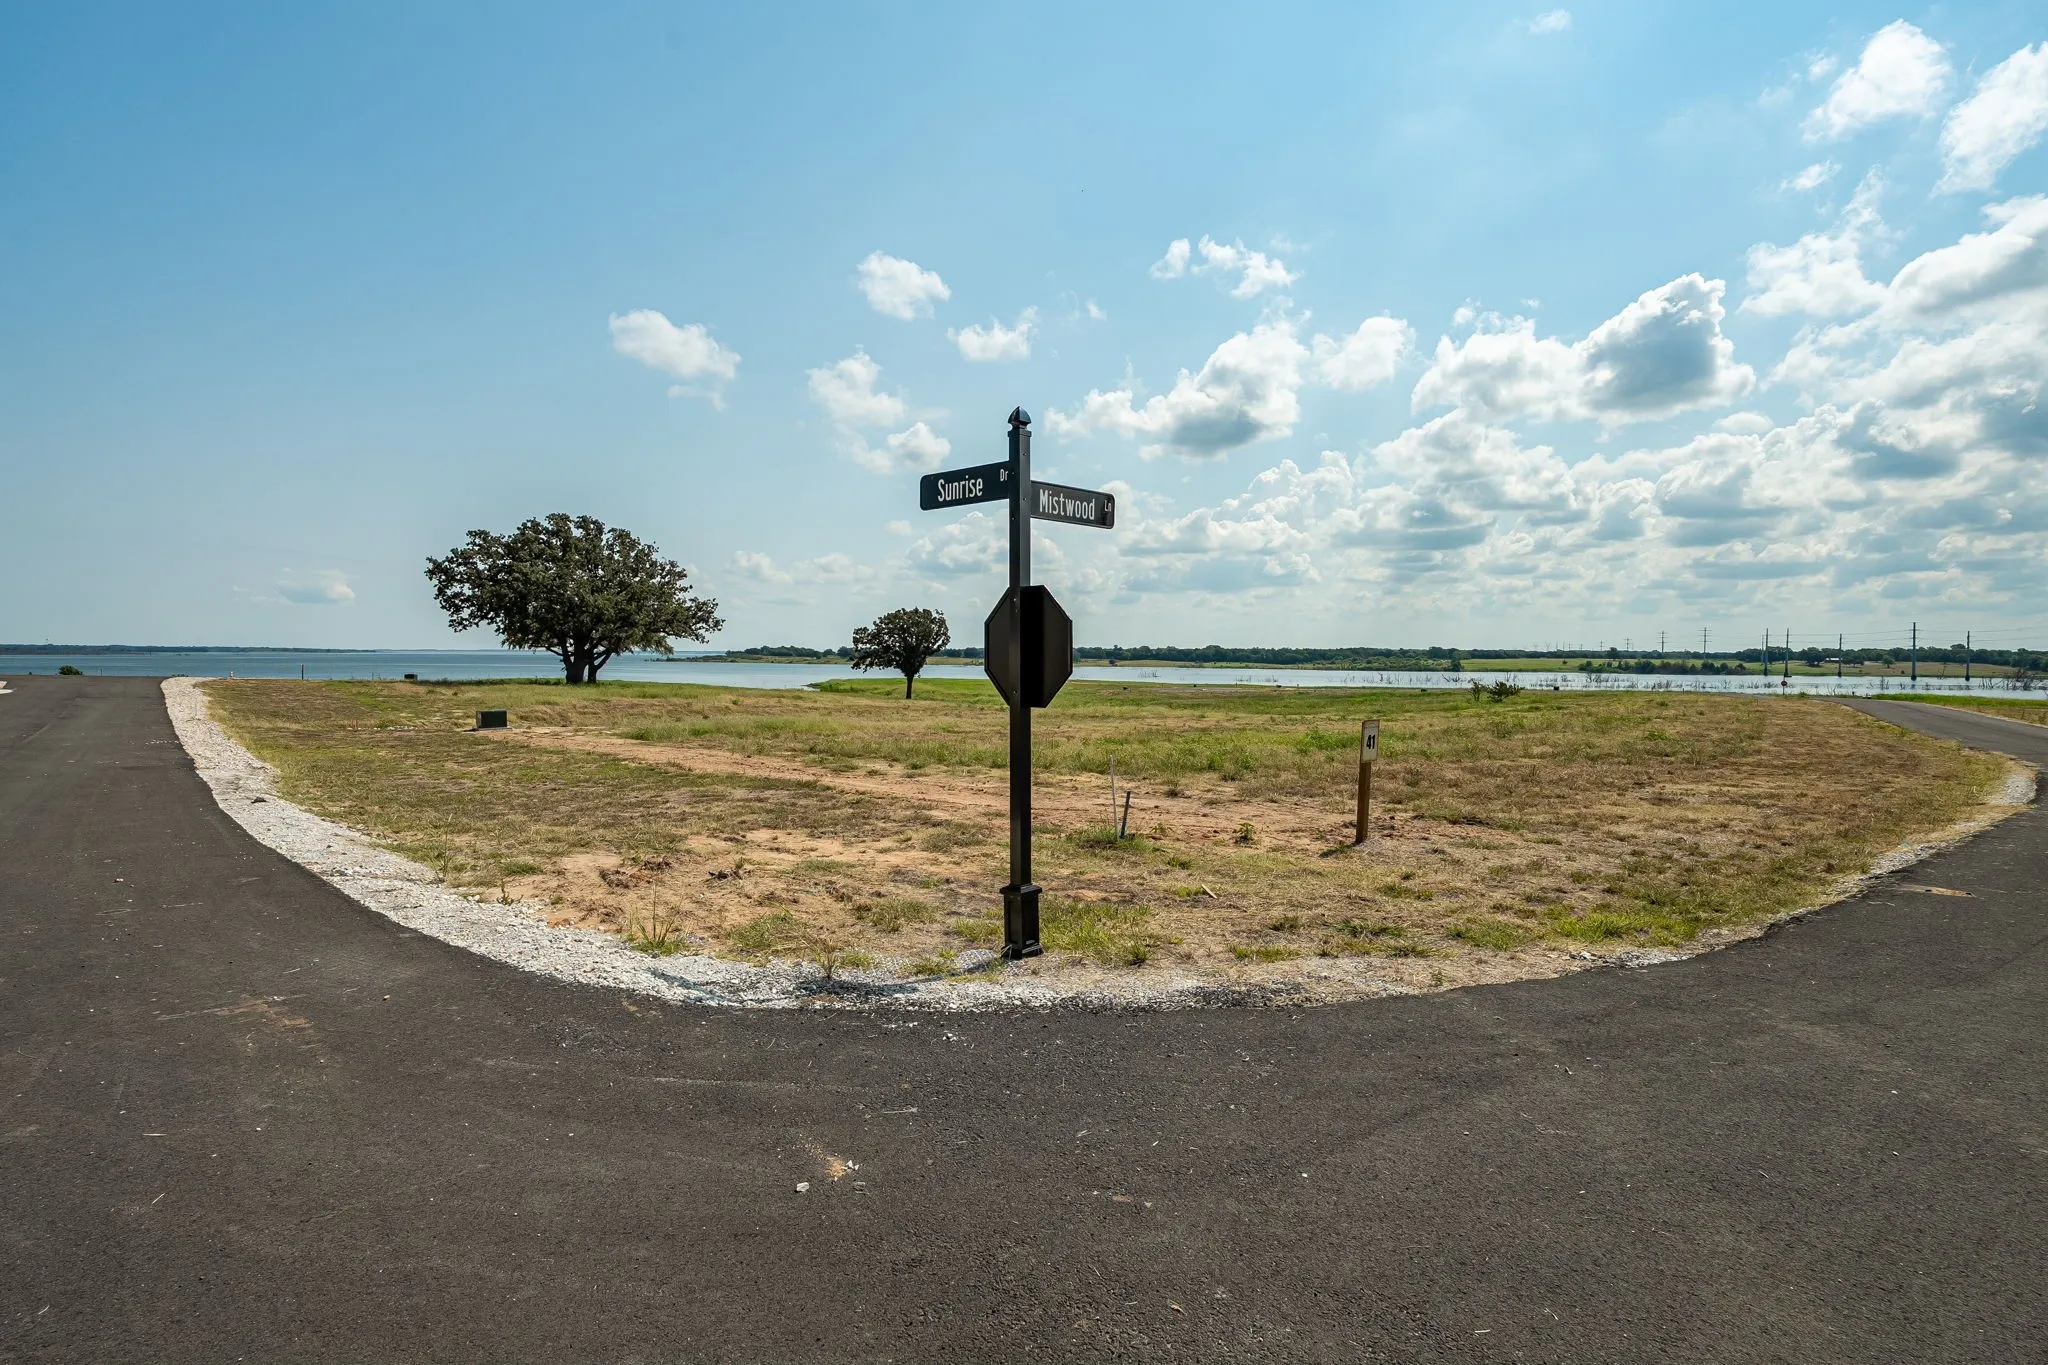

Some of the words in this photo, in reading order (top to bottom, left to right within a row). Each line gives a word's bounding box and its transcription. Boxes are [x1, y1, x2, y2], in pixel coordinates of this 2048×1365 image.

[938, 475, 983, 502] Sunrise
[1000, 469, 1009, 482] Dr
[1040, 489, 1095, 520] Mistwood
[1104, 500, 1112, 512] Ln
[1366, 734, 1375, 749] 41
